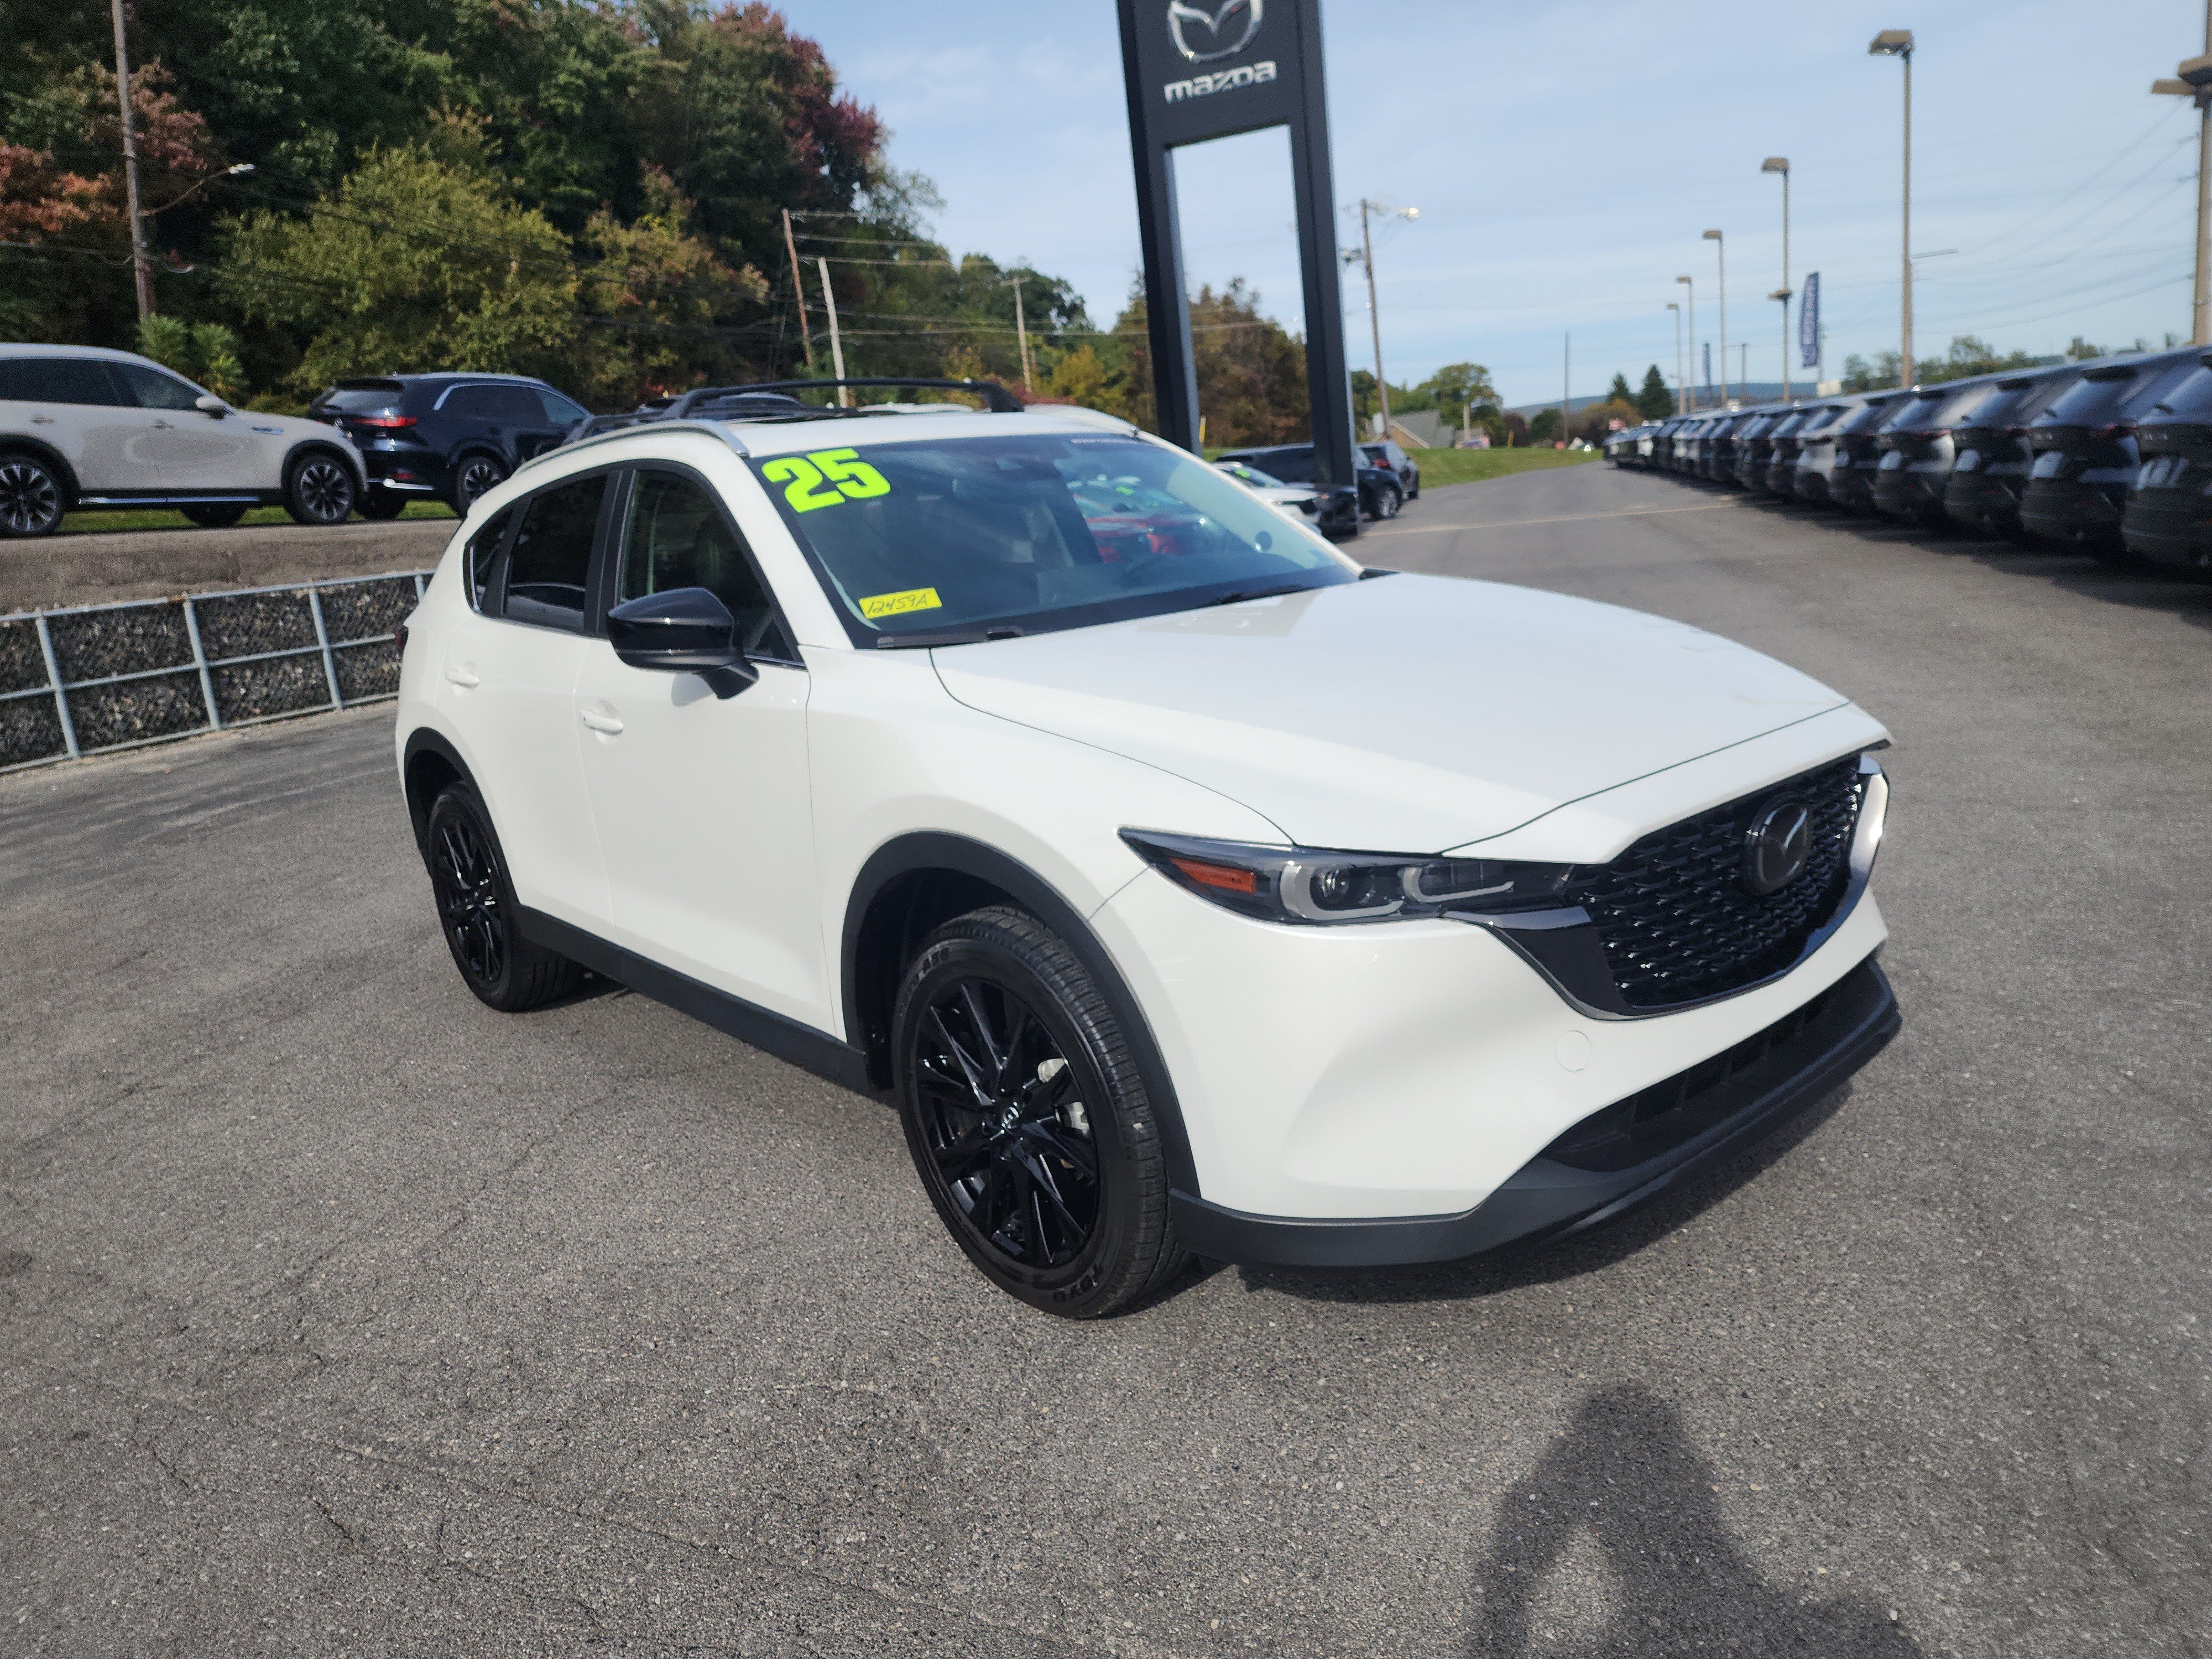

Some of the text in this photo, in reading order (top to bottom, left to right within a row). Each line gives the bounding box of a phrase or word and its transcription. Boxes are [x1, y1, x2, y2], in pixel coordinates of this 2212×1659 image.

[1164, 61, 1276, 103] mazda
[761, 447, 891, 513] 25
[867, 591, 931, 614] 12459A
